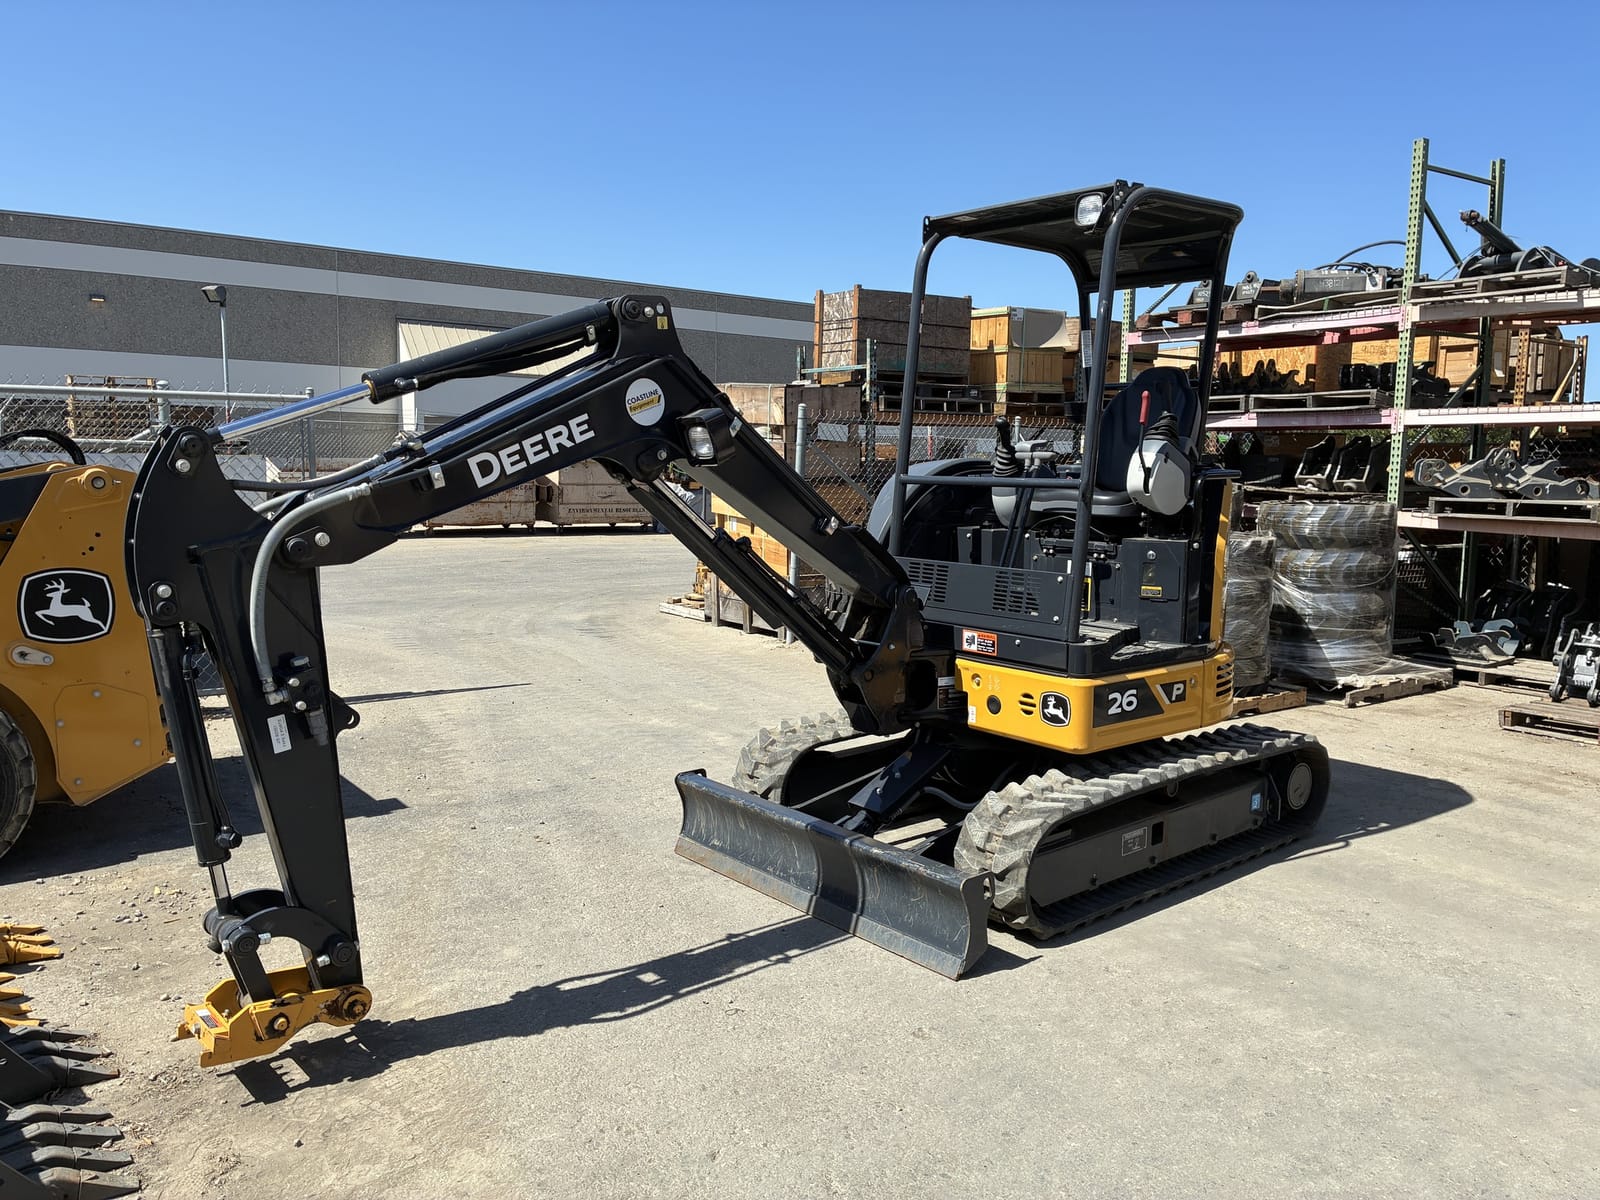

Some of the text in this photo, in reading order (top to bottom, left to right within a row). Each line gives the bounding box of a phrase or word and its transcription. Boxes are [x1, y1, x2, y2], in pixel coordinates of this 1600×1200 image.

[627, 388, 659, 405] COASTLINE
[466, 413, 594, 488] DEERE
[1107, 684, 1184, 715] 26 P
